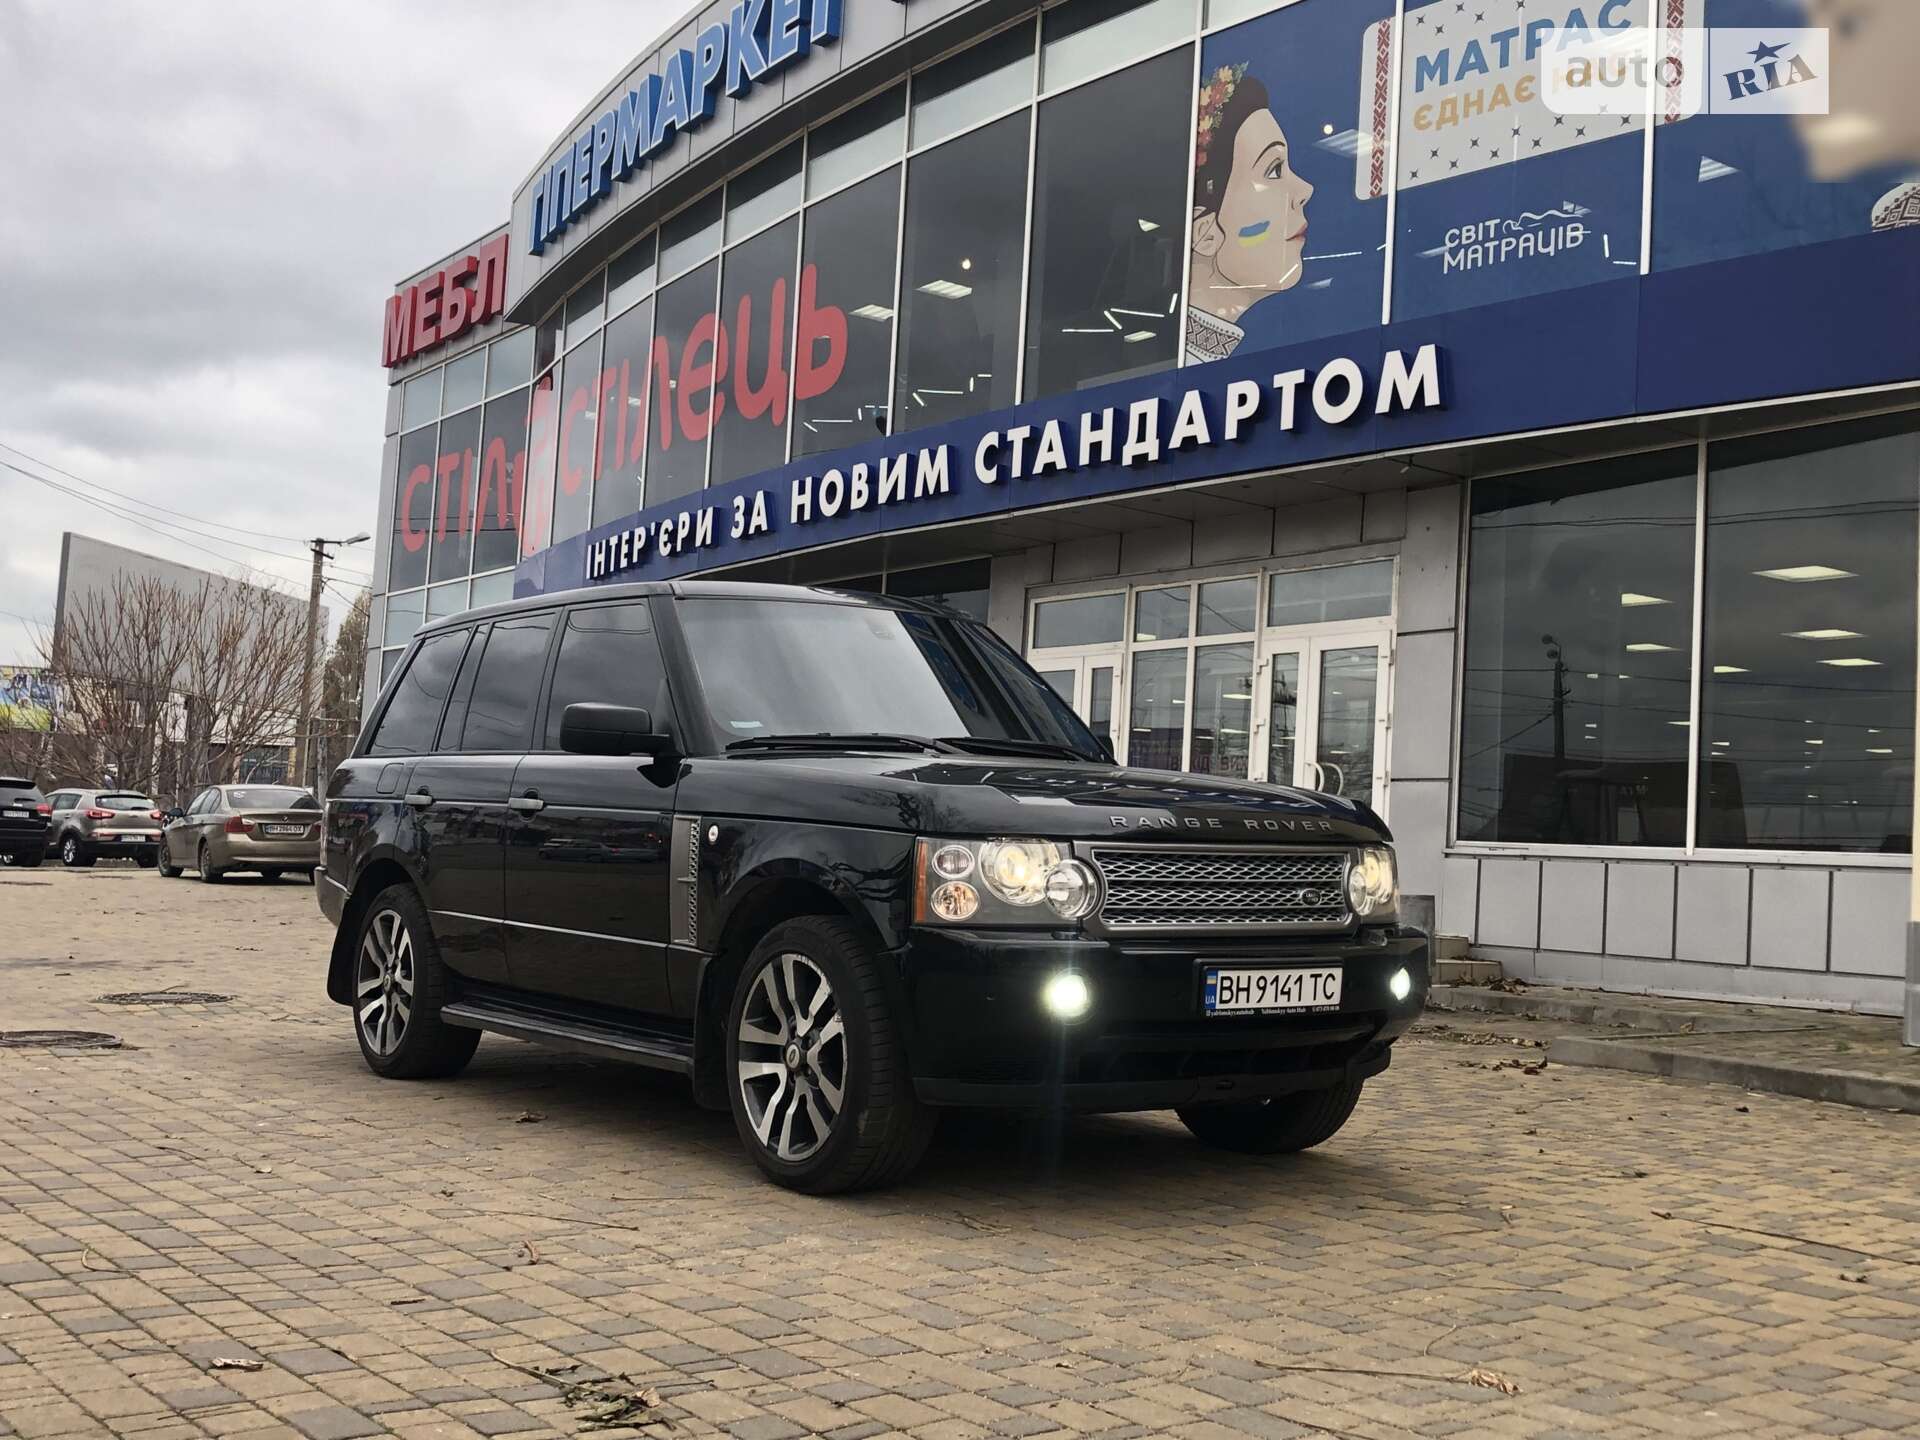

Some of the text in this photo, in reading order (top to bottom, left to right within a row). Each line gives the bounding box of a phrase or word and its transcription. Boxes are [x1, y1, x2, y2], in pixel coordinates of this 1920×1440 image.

[1415, 0, 1632, 93] МАТРАС
[1413, 74, 1536, 131] ЄДНАЄ
[1443, 222, 1585, 275] МАТРАЦІВ
[1445, 218, 1501, 249] СВІТ
[381, 232, 509, 369] МЕБЛ
[730, 489, 769, 540] ЗА
[790, 443, 950, 525] НОВИМ
[974, 342, 1441, 486] СТАНДАРТОМ
[1110, 815, 1333, 832] RANGE ROVER
[1205, 994, 1216, 1005] UA
[1218, 972, 1337, 1004] BH 9141 TC
